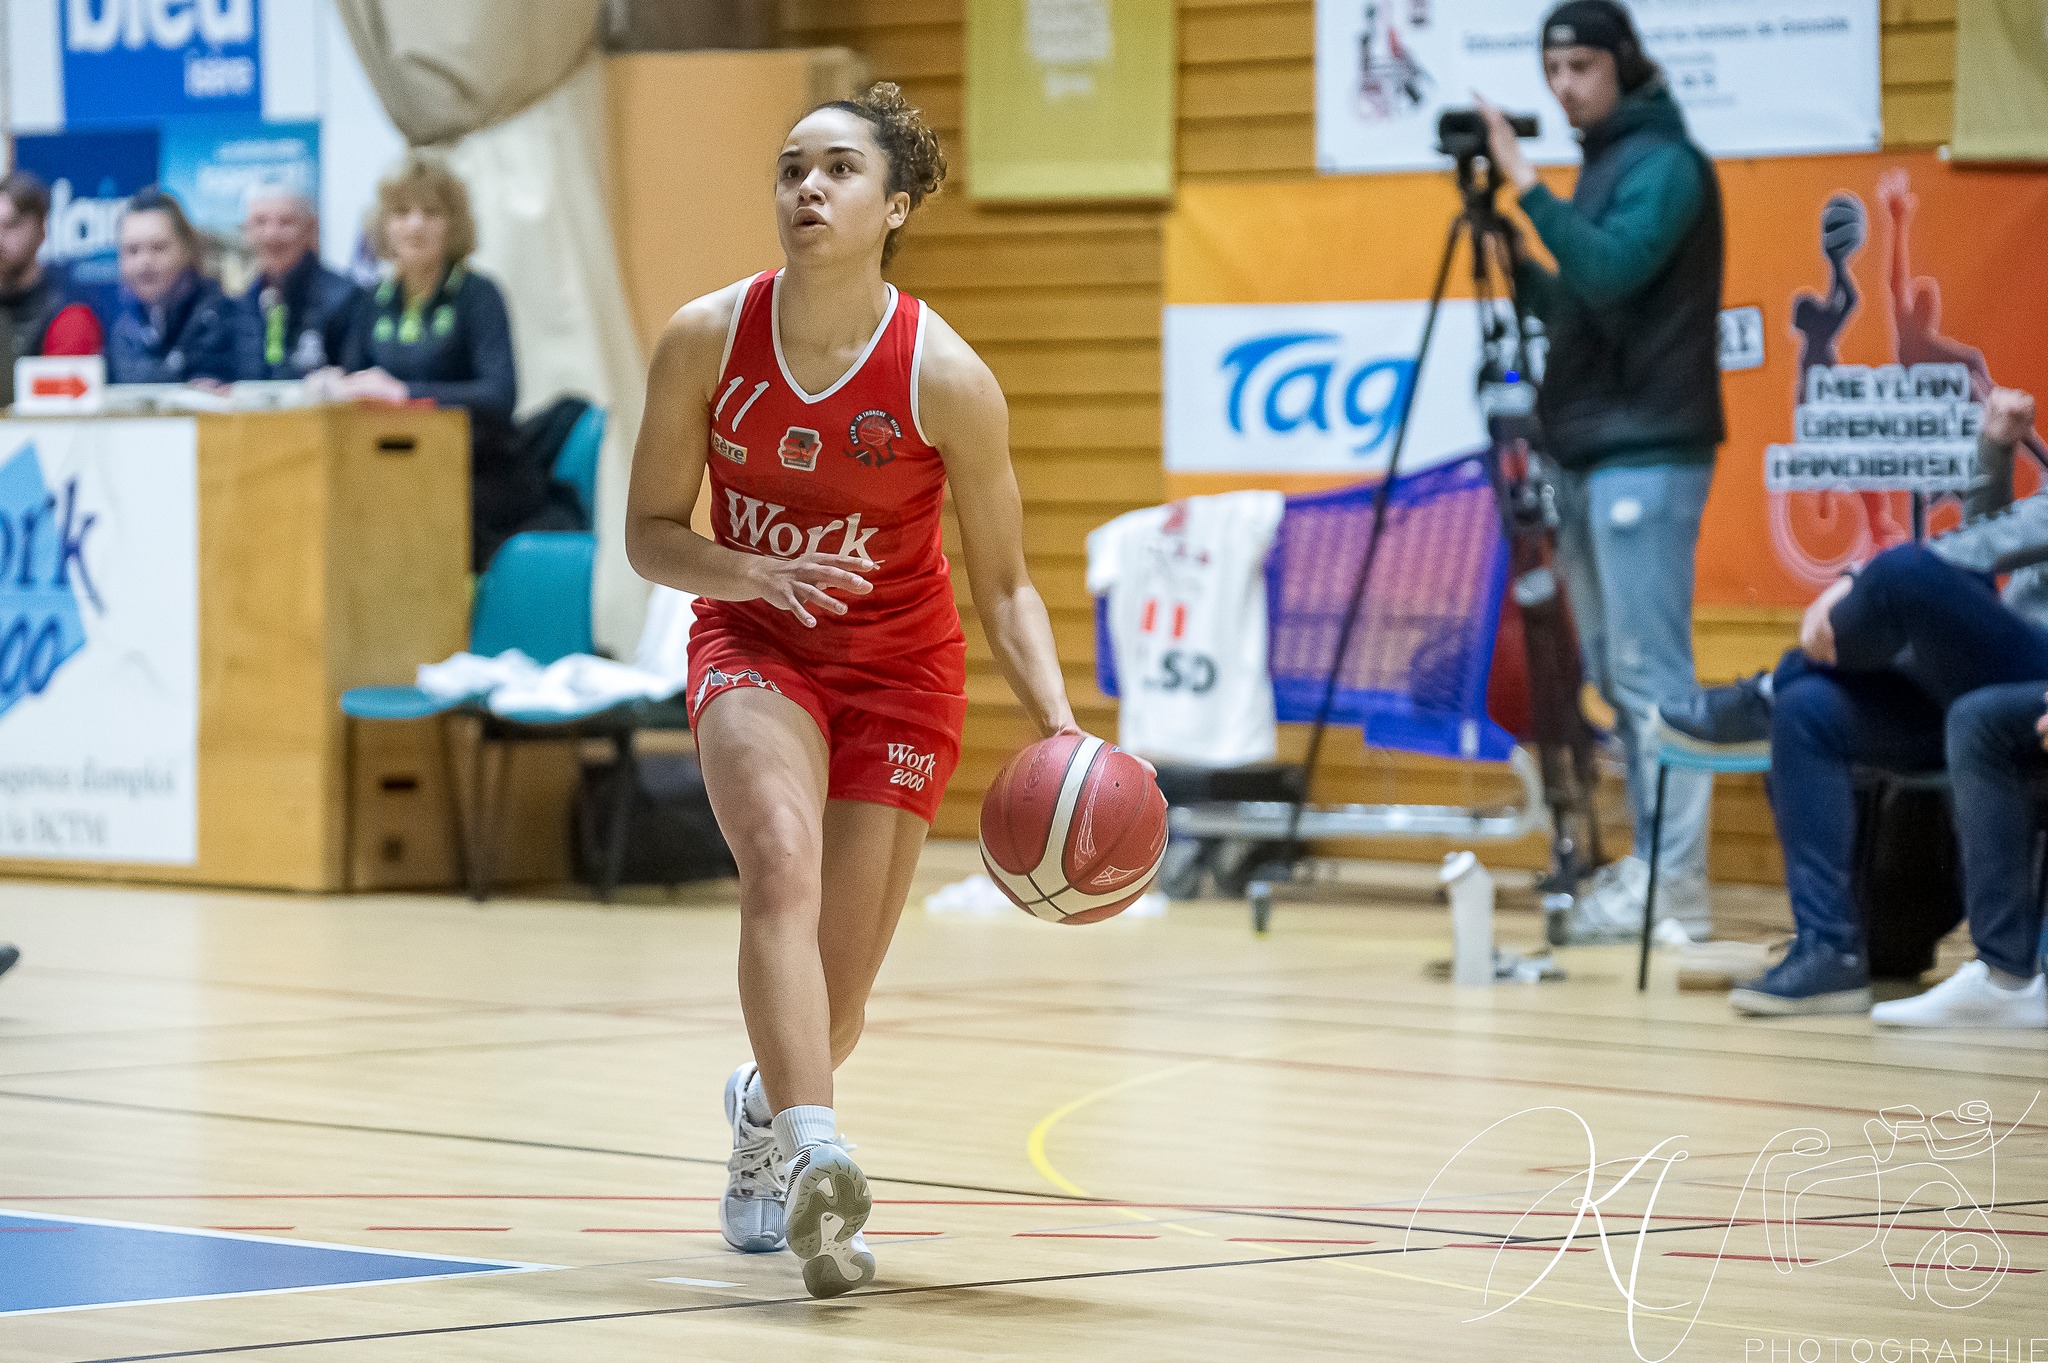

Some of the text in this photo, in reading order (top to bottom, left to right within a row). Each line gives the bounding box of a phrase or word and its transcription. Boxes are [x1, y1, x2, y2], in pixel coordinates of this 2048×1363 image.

[713, 375, 770, 433] 11
[1220, 327, 1417, 455] Tag
[1816, 377, 1962, 399] MEYLAN
[1803, 408, 1978, 437] GRENOBLE
[724, 487, 880, 570] Work
[887, 743, 936, 781] Work
[890, 768, 925, 792] 2000
